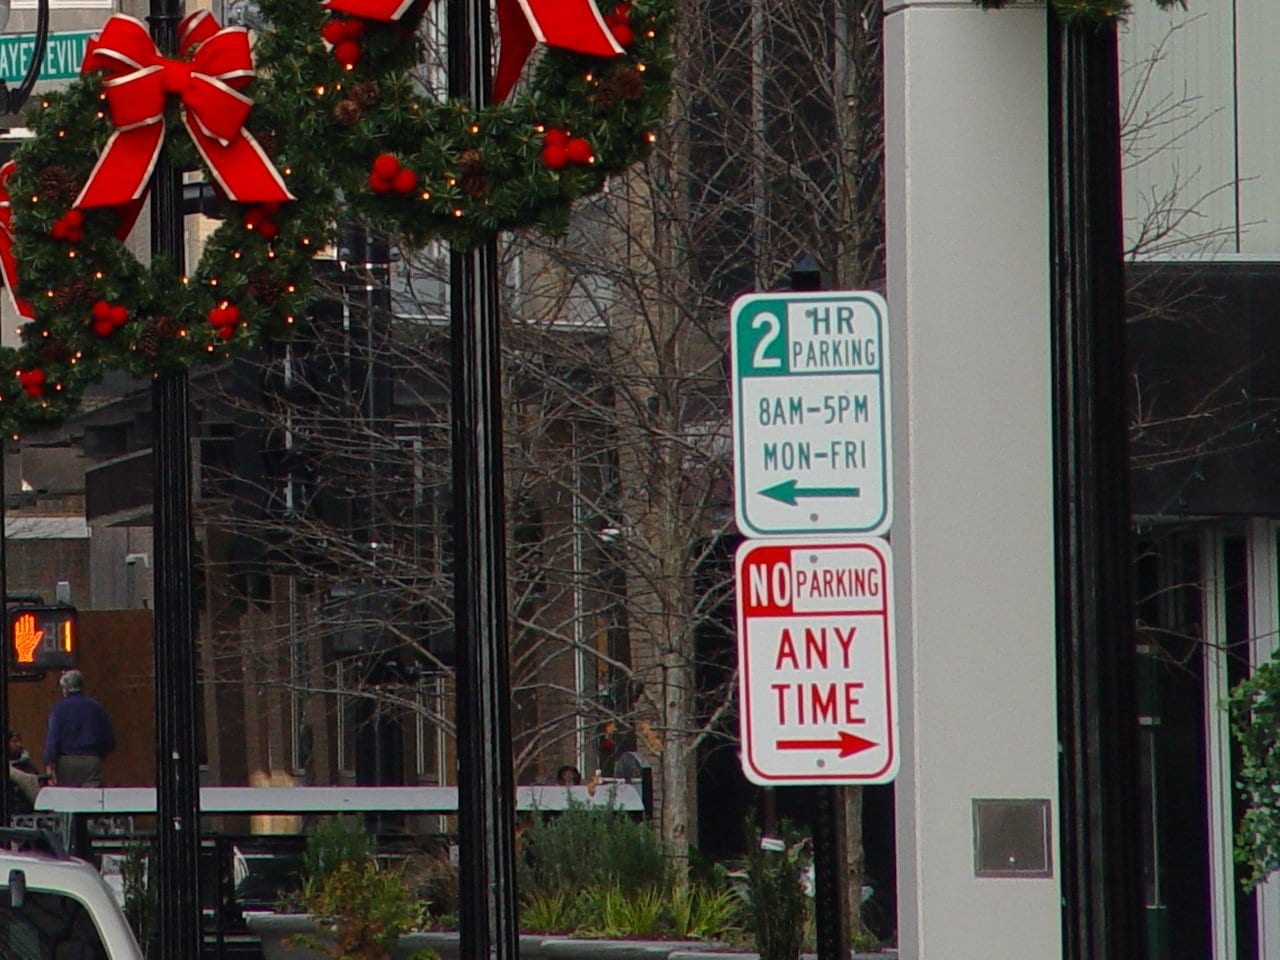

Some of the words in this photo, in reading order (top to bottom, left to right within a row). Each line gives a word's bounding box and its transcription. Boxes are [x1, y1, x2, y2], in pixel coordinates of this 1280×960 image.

[751, 311, 782, 369] 2
[812, 306, 855, 335] HR
[793, 339, 876, 368] PARKING
[759, 394, 869, 426] 8AM-5PM
[763, 440, 866, 471] MON-FRI
[749, 562, 792, 608] NO
[796, 568, 879, 599] PARKING
[775, 626, 857, 670] ANY
[771, 682, 866, 726] TIME
